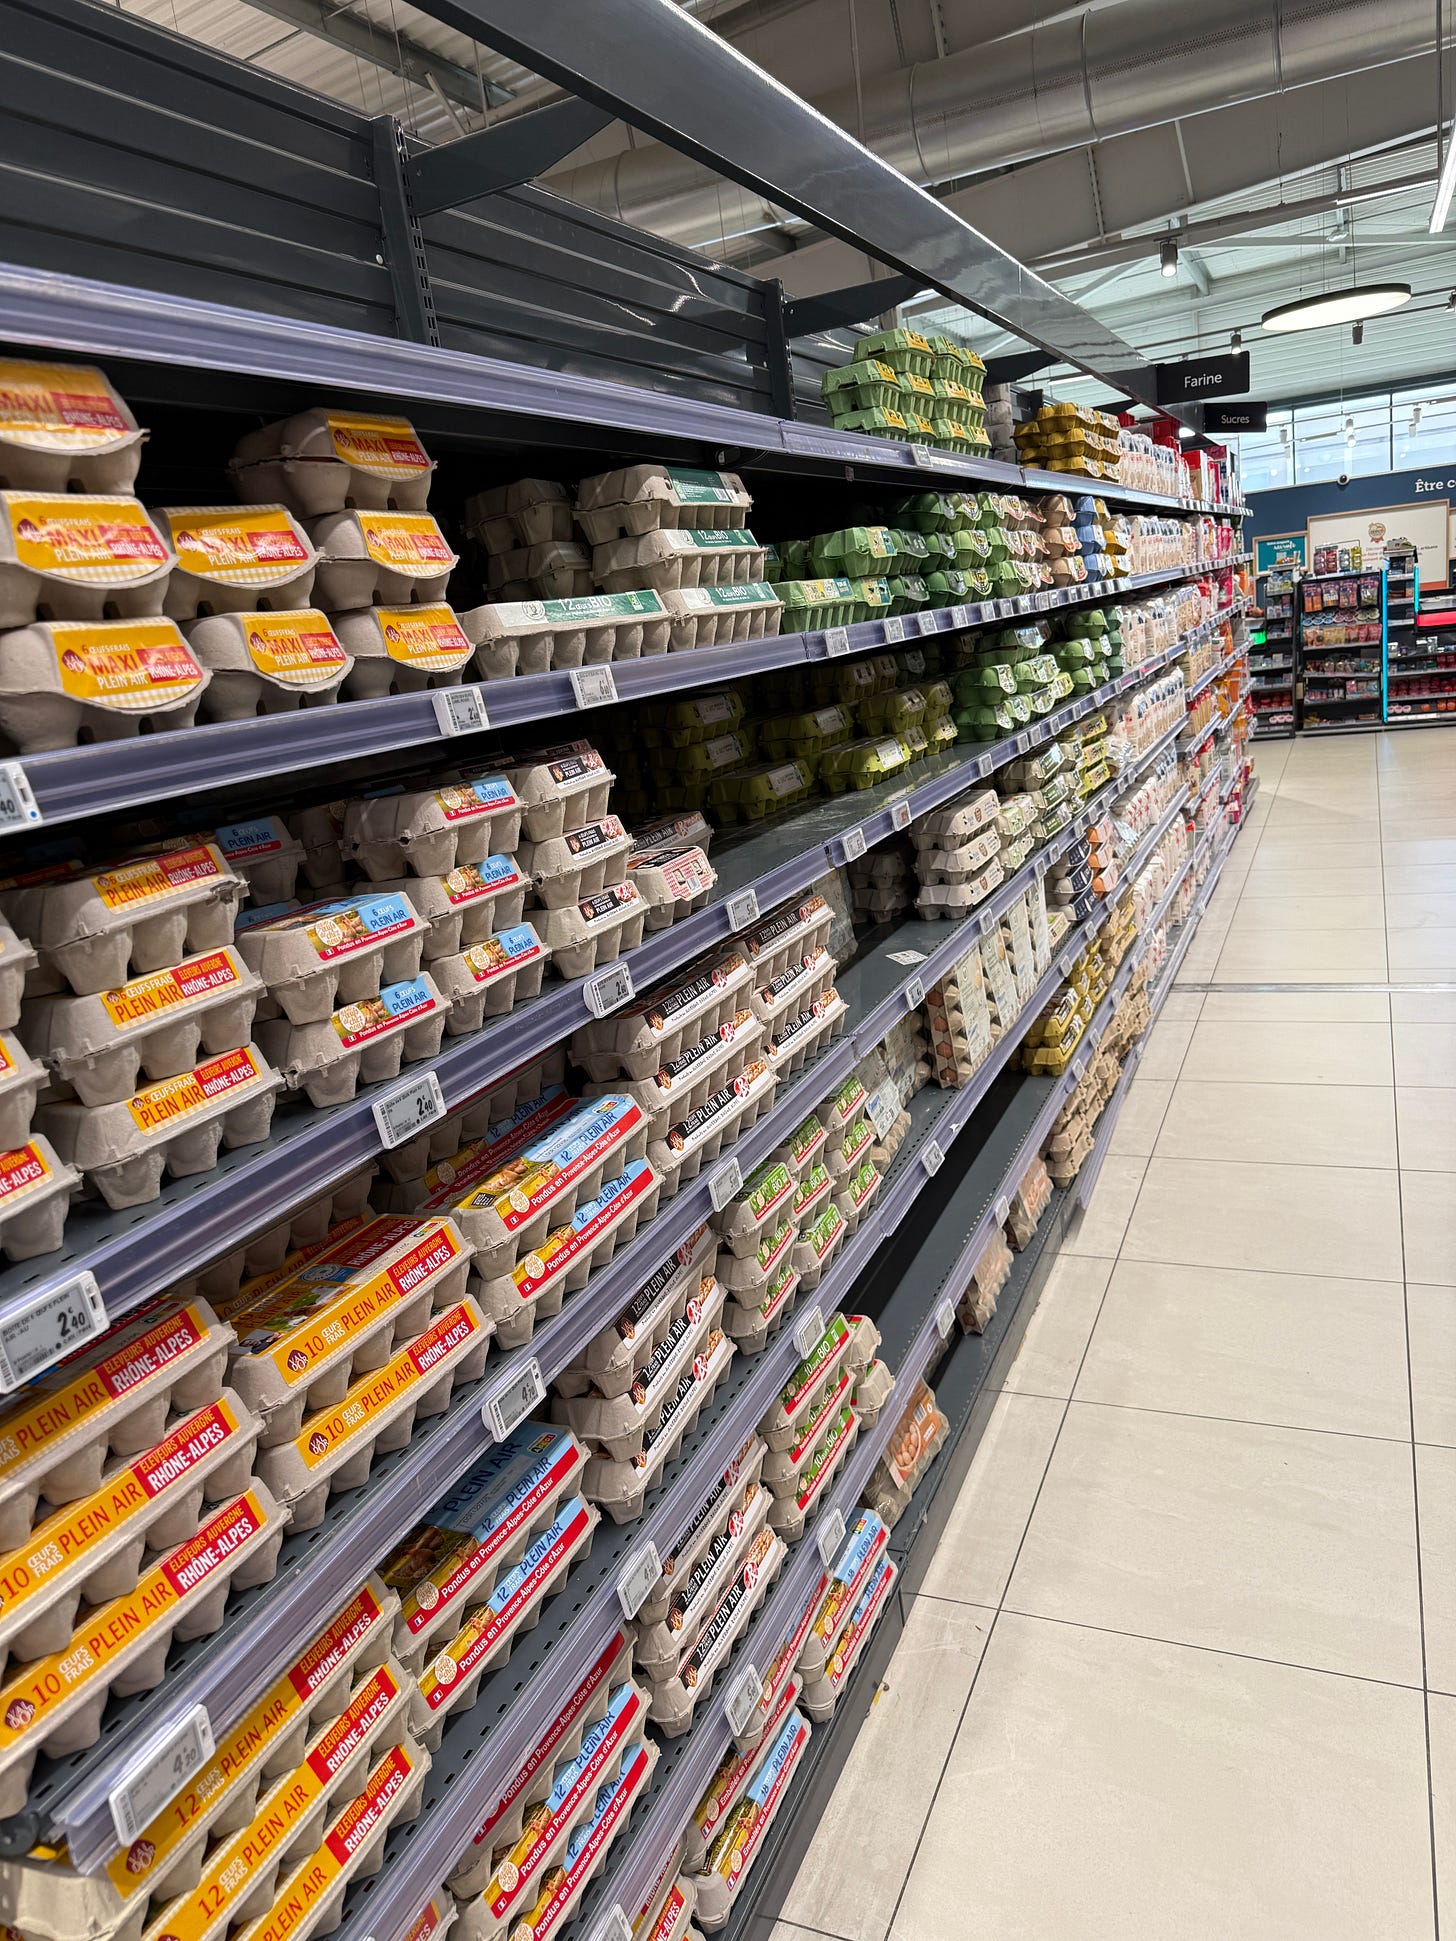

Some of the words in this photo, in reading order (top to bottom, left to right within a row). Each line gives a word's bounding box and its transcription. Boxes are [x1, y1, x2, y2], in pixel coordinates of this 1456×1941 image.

[1184, 371, 1222, 389] Farine
[1221, 413, 1250, 425] Sucres
[352, 437, 386, 453] MAXI
[1415, 478, 1444, 493] Être
[715, 531, 729, 540] BIO
[208, 553, 237, 566] PLEIN
[558, 598, 576, 611] 12
[591, 596, 612, 608] BIO
[734, 587, 747, 596] BIO
[267, 637, 301, 655] MAXI
[401, 630, 432, 646] MAXI
[408, 643, 428, 655] PLEIN
[90, 654, 139, 675] MAXI
[149, 664, 198, 679] RHÔNE-ALPES
[275, 653, 297, 666] PLEIN
[298, 652, 311, 664] AIR
[97, 675, 128, 690] PLEIN
[130, 672, 148, 686] AIR
[481, 790, 497, 801] PLEIN
[497, 788, 508, 798] AIR
[227, 834, 255, 850] PLEIN
[256, 831, 273, 844] AIR
[168, 861, 216, 885] RHÔNE-ALPES
[485, 869, 501, 881] PLEIN
[501, 866, 512, 877] AIR
[106, 881, 147, 906] PLEIN
[150, 872, 171, 892] AIR
[370, 912, 392, 930] PLEIN
[393, 909, 407, 921] AIR
[372, 908, 378, 917] 6
[771, 918, 788, 935] PLEIN
[787, 913, 798, 925] AIR
[509, 943, 524, 955] PLEIN
[524, 939, 534, 950] AIR
[150, 974, 174, 990] FRAIS
[181, 968, 233, 996] RHÔNE-ALPES
[395, 991, 401, 999] 6
[676, 986, 698, 1006] PLEIN
[697, 977, 711, 992] AIR
[115, 995, 155, 1022] PLEIN
[158, 985, 183, 1006] AIR
[392, 996, 414, 1013] PLEIN
[414, 991, 427, 1004] AIR
[203, 1064, 254, 1096] RHÔNE-ALPES
[140, 1101, 180, 1128] PLEIN
[183, 1085, 206, 1109] AIR
[698, 1100, 718, 1123] PLEIN
[717, 1088, 732, 1108] AIR
[560, 1150, 572, 1163] 12
[579, 1124, 603, 1145] PLEIN
[603, 1112, 617, 1128] AIR
[531, 1183, 556, 1206] Pondus
[576, 1212, 587, 1225] 12
[596, 1185, 618, 1208] PLEIN
[617, 1172, 632, 1191] AIR
[418, 1235, 444, 1259] AUVERGNE
[546, 1248, 571, 1271] Pondus
[400, 1246, 451, 1291] RHÔNE-ALPES
[643, 1272, 665, 1300] PLEIN
[664, 1258, 677, 1280] AIR
[145, 1315, 185, 1347] AUVERGNE
[304, 1335, 325, 1358] 10
[341, 1297, 375, 1331] PLEIN
[376, 1282, 396, 1306] AIR
[321, 1320, 341, 1338] ŒUFS
[437, 1311, 463, 1340] AUVERGNE
[326, 1327, 346, 1346] FRAIS
[418, 1321, 469, 1371] RHÔNE-ALPES
[656, 1333, 677, 1363] PLEIN
[674, 1318, 687, 1338] AIR
[817, 1340, 831, 1358] BIO
[111, 1329, 193, 1393] RHÔNE-ALPES
[325, 1417, 345, 1441] 10
[361, 1379, 395, 1412] PLEIN
[396, 1361, 415, 1386] AIR
[16, 1403, 72, 1450] PLEIN
[71, 1382, 106, 1413] AIR
[178, 1410, 215, 1445] AUVERGNE
[346, 1410, 365, 1428] FRAIS
[147, 1422, 224, 1492] RHÔNE-ALPES
[443, 1469, 496, 1513] PLEIN
[494, 1442, 523, 1470] AIR
[481, 1517, 495, 1533] 12
[506, 1474, 534, 1507] PLEIN
[535, 1456, 553, 1481] AIR
[207, 1504, 245, 1540] AUVERGNE
[1, 1566, 30, 1599] 10
[58, 1505, 111, 1554] PLEIN
[113, 1482, 143, 1515] AIR
[441, 1566, 471, 1598] Pondus
[470, 1556, 481, 1569] en
[479, 1494, 538, 1560] Provence-Alpes-Côte
[535, 1477, 554, 1498] d'Azur
[27, 1541, 58, 1569] ŒUFS
[33, 1551, 64, 1578] FRAIS
[177, 1517, 253, 1590] RHÔNE-ALPES
[497, 1586, 510, 1603] 12
[520, 1540, 546, 1575] PLEIN
[546, 1522, 564, 1545] AIR
[695, 1555, 715, 1585] PLEIN
[332, 1599, 364, 1641] AUVERGNE
[459, 1640, 488, 1672] Pondus
[487, 1627, 498, 1640] en
[495, 1564, 551, 1629] Provence-Alpes-Côte
[548, 1543, 565, 1564] d'Azur
[710, 1604, 731, 1638] PLEIN
[729, 1585, 743, 1607] AIR
[32, 1673, 61, 1707] 10
[88, 1611, 140, 1658] PLEIN
[142, 1581, 173, 1617] AIR
[307, 1613, 372, 1690] RHÔNE-ALPES
[58, 1646, 89, 1675] ŒUFS
[65, 1657, 94, 1684] FRAIS
[349, 1678, 382, 1719] AUVERGNE
[327, 1692, 389, 1773] RHÔNE-ALPES
[501, 1769, 529, 1804] Pondus
[527, 1755, 538, 1772] en
[535, 1687, 588, 1761] Provence-Alpes-Côte
[585, 1667, 603, 1694] d'Azur
[174, 1793, 201, 1828] 12
[221, 1726, 262, 1778] PLEIN
[264, 1700, 289, 1733] AIR
[554, 1783, 567, 1801] 12
[575, 1732, 601, 1769] PLEIN
[600, 1710, 616, 1736] AIR
[201, 1777, 225, 1802] FRAIS
[366, 1758, 396, 1799] AUVERGNE
[719, 1773, 740, 1806] Emballés
[344, 1769, 404, 1853] RHÔNE-ALPES
[520, 1837, 547, 1877] Pondus
[545, 1821, 556, 1839] en
[553, 1749, 605, 1827] Provence-Alpes-Côte
[602, 1730, 618, 1756] d'Azur
[199, 1884, 225, 1920] 12
[243, 1813, 285, 1865] PLEIN
[283, 1784, 310, 1818] AIR
[567, 1842, 579, 1861] 12
[743, 1823, 761, 1857] Emballés
[219, 1856, 243, 1885] ŒUFS
[535, 1897, 560, 1938] Pondus
[559, 1884, 570, 1900] en
[567, 1806, 616, 1887] Provence-Alpes-Côte
[612, 1787, 628, 1812] d'Azur
[224, 1866, 248, 1893] FRAIS
[302, 1866, 328, 1902] AIR
